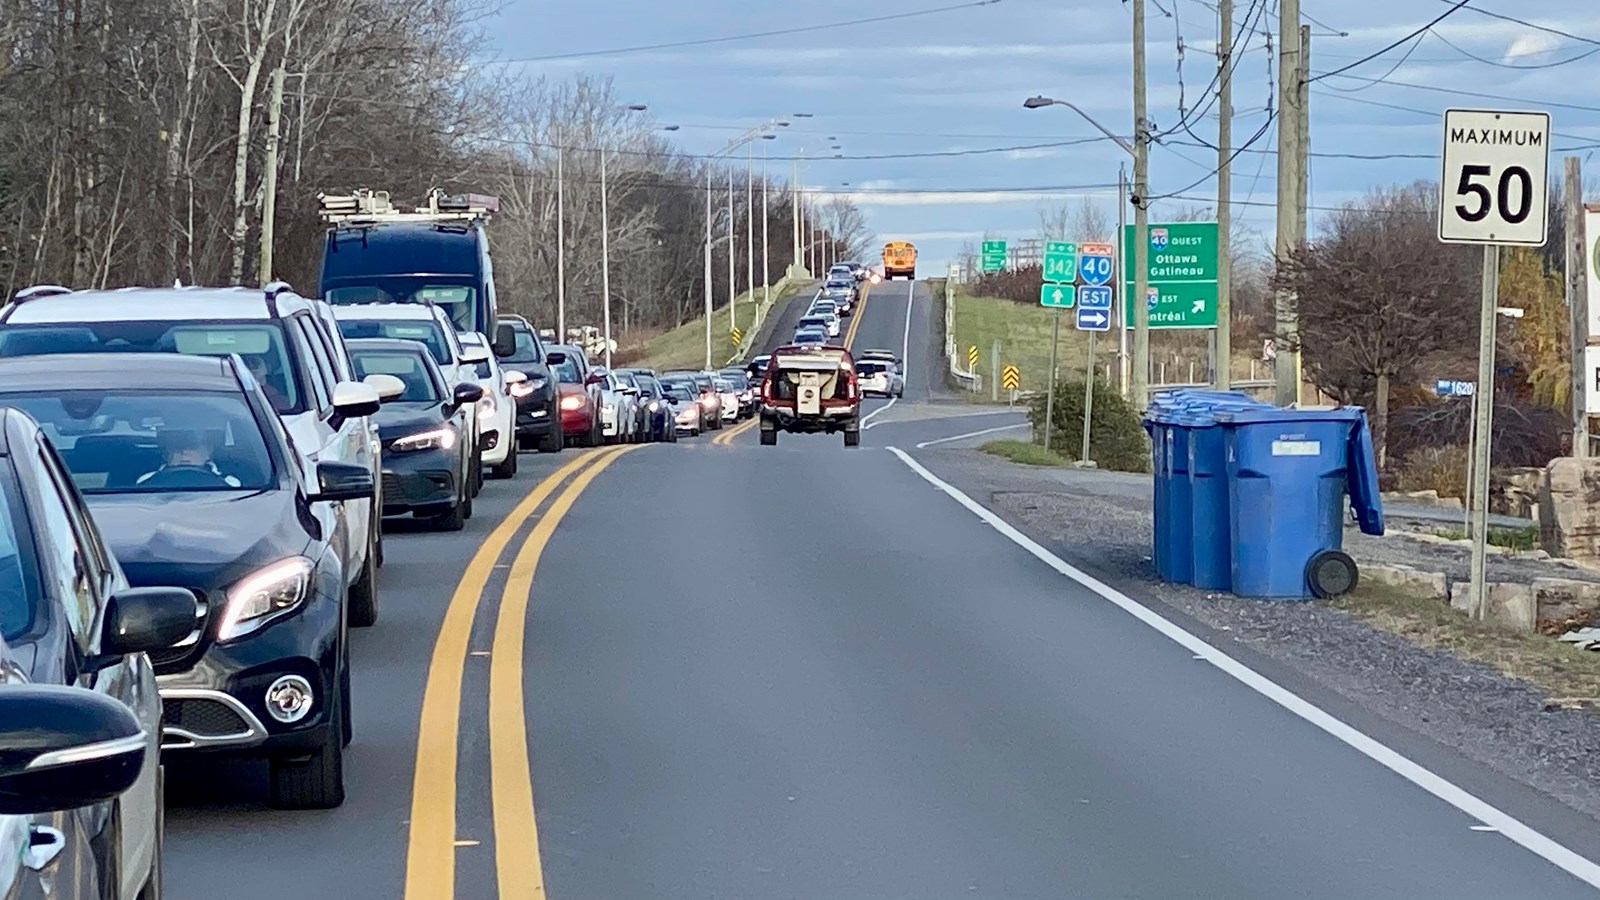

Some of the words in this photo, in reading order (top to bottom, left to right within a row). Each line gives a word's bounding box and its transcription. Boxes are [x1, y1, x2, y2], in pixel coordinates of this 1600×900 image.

[1451, 127, 1543, 147] MAXIMUM
[1455, 164, 1533, 224] 50
[1152, 236, 1168, 245] 40
[1171, 236, 1202, 245] OUEST
[1155, 254, 1198, 264] Ottawa
[1047, 258, 1073, 276] 342
[1083, 258, 1110, 275] 40
[1150, 266, 1204, 276] Gatineau
[1081, 290, 1108, 304] EST
[1161, 294, 1178, 303] EST
[1148, 311, 1186, 321] ntréal
[1451, 381, 1474, 396] 1620
